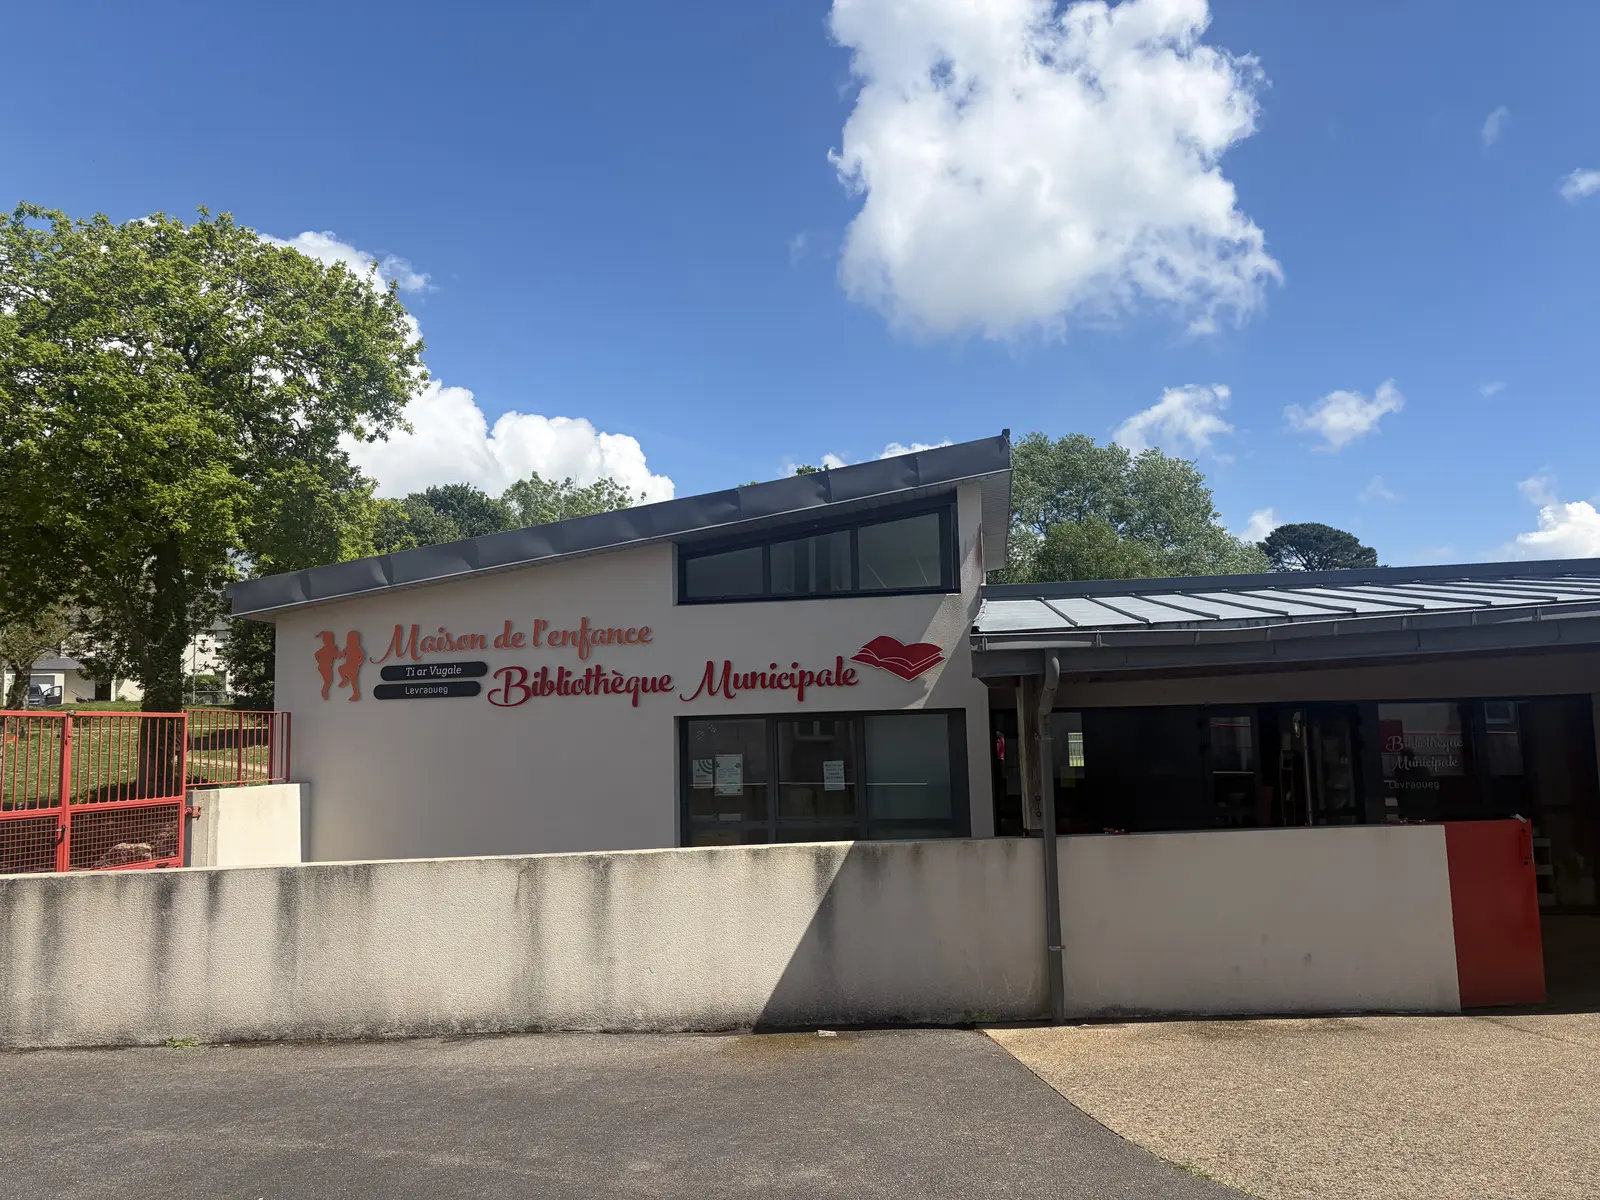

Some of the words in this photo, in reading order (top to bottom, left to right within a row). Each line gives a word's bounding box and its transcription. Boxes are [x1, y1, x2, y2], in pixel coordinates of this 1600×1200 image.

[369, 623, 488, 664] Maison
[493, 619, 527, 649] de
[532, 616, 652, 661] l'enfance
[405, 667, 415, 677] Ti
[417, 668, 427, 676] ar
[429, 665, 462, 677] Vugale
[405, 686, 449, 695] Levraoueg
[487, 665, 675, 707] Bibliothèque
[679, 655, 859, 702] Municipale
[1392, 754, 1459, 773] Municipale
